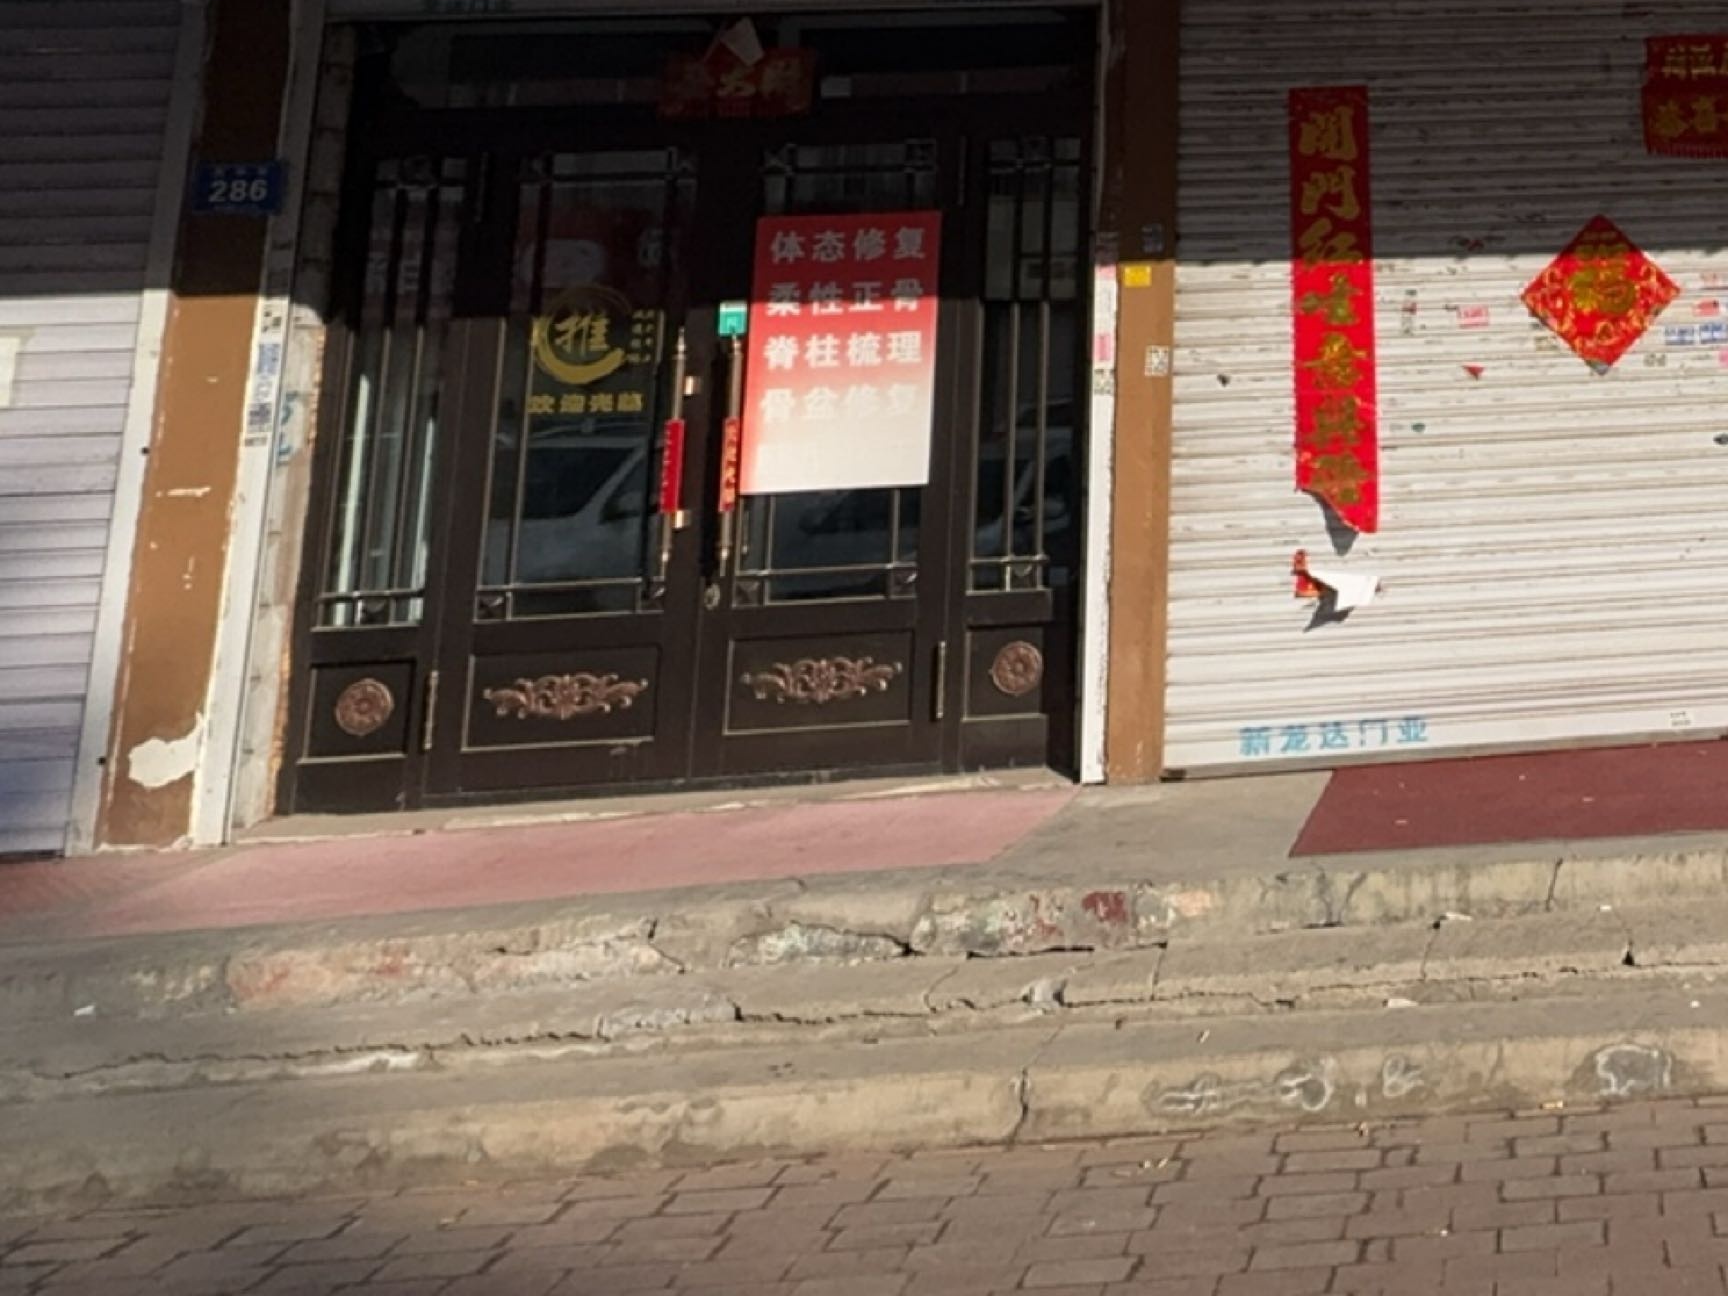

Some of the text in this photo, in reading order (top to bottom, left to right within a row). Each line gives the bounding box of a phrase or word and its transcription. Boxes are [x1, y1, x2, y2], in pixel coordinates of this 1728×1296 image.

[207, 178, 270, 204] 286
[770, 227, 925, 264] 体态修复
[765, 278, 924, 317] 柔性正骨
[764, 330, 923, 370] 脊柱梳理
